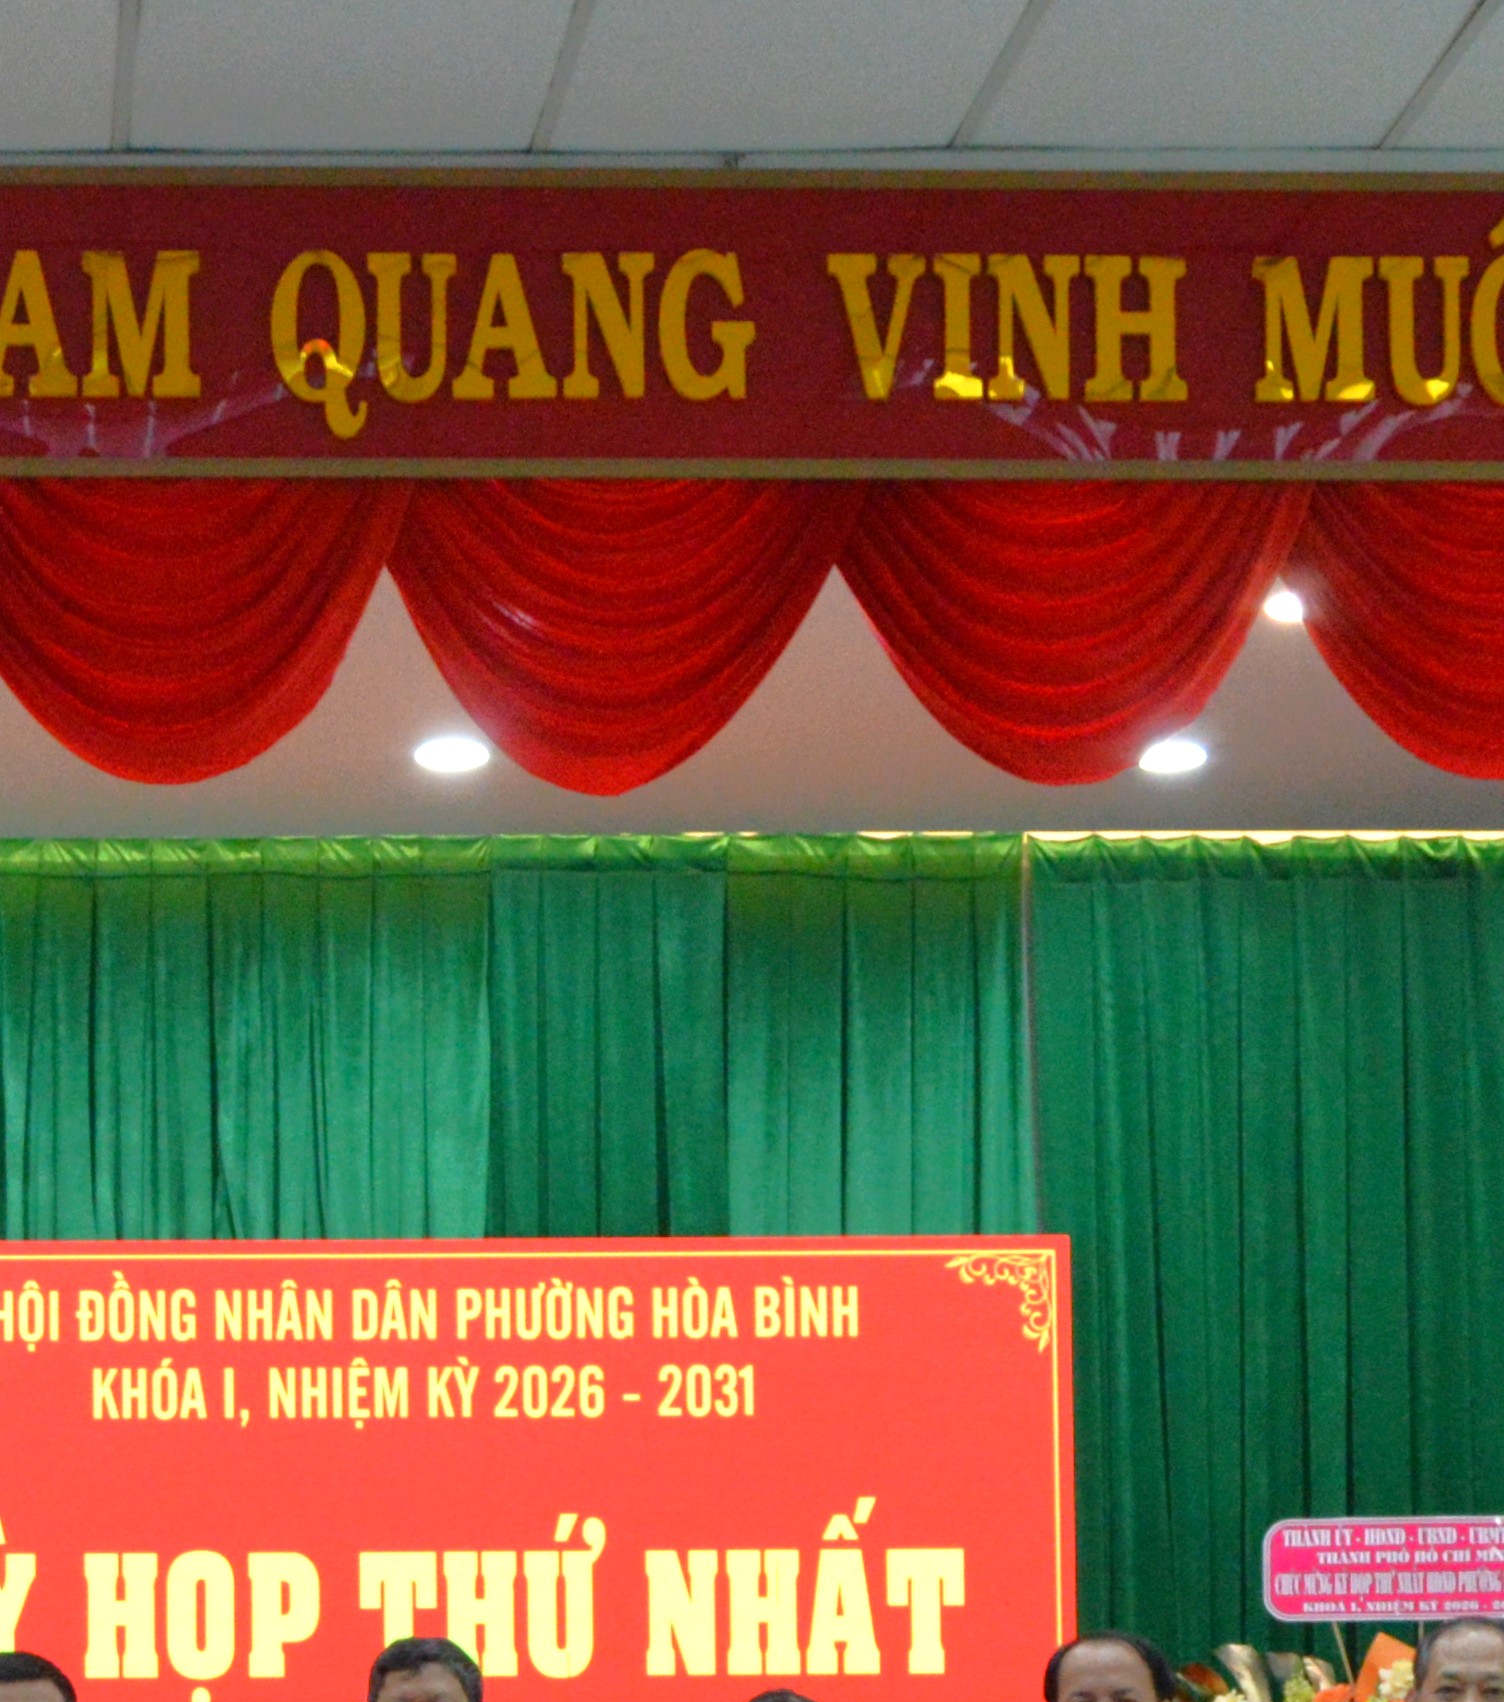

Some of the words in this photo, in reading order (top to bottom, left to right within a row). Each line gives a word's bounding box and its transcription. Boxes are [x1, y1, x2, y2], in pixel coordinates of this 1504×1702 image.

[270, 249, 756, 440] QUANG
[826, 253, 1188, 402] VINH
[76, 1270, 197, 1342] ĐỒNG
[214, 1278, 334, 1342] NHÂN
[351, 1278, 438, 1341] DÂN
[455, 1277, 635, 1341] PHƯỜNG
[651, 1276, 739, 1340] HÒA
[754, 1275, 860, 1339] BÌNH
[92, 1358, 208, 1421] KHÓA
[222, 1367, 252, 1429] I,
[268, 1357, 410, 1429] NHIỆM
[427, 1356, 481, 1419] KỲ
[493, 1365, 606, 1419] 2026
[657, 1364, 756, 1418] 2031
[359, 1511, 609, 1680] THỨ
[645, 1496, 968, 1677] NHẤT
